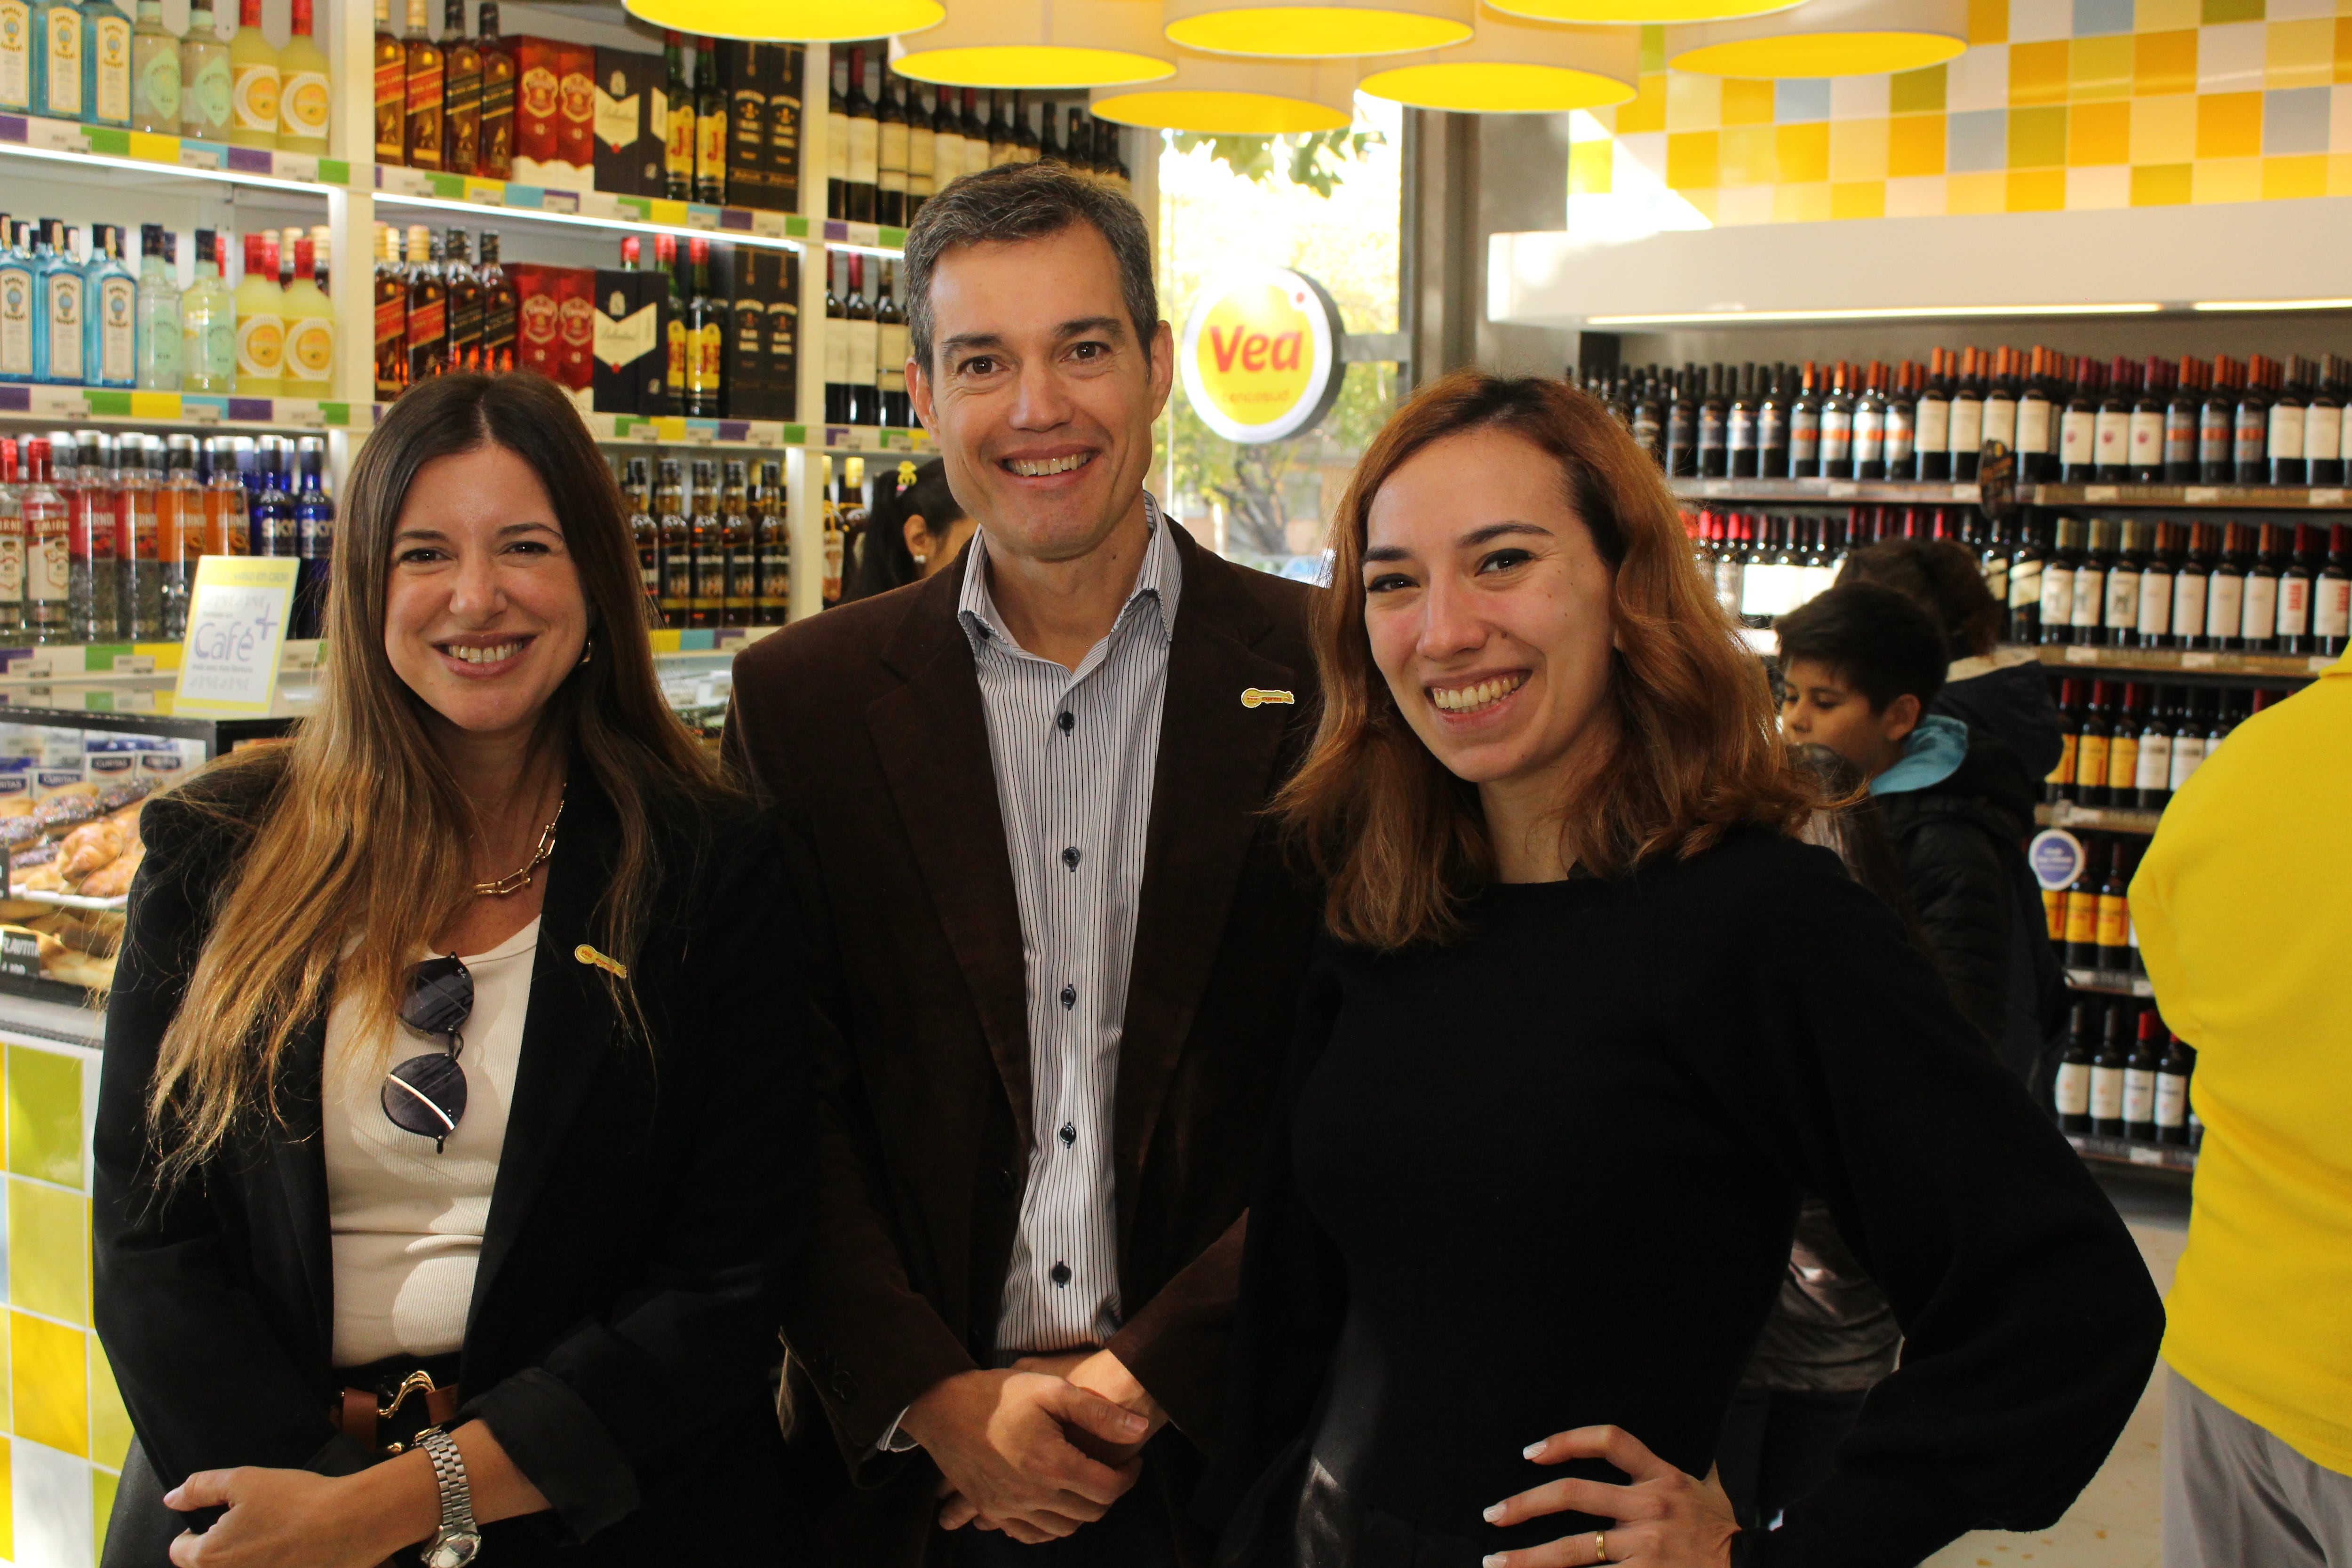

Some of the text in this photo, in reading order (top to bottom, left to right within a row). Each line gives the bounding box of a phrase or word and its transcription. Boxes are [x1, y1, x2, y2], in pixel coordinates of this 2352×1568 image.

[1209, 324, 1303, 373] Vea
[1221, 389, 1290, 403] cencosud
[34, 520, 69, 532] SMIRN
[596, 958, 615, 970] express
